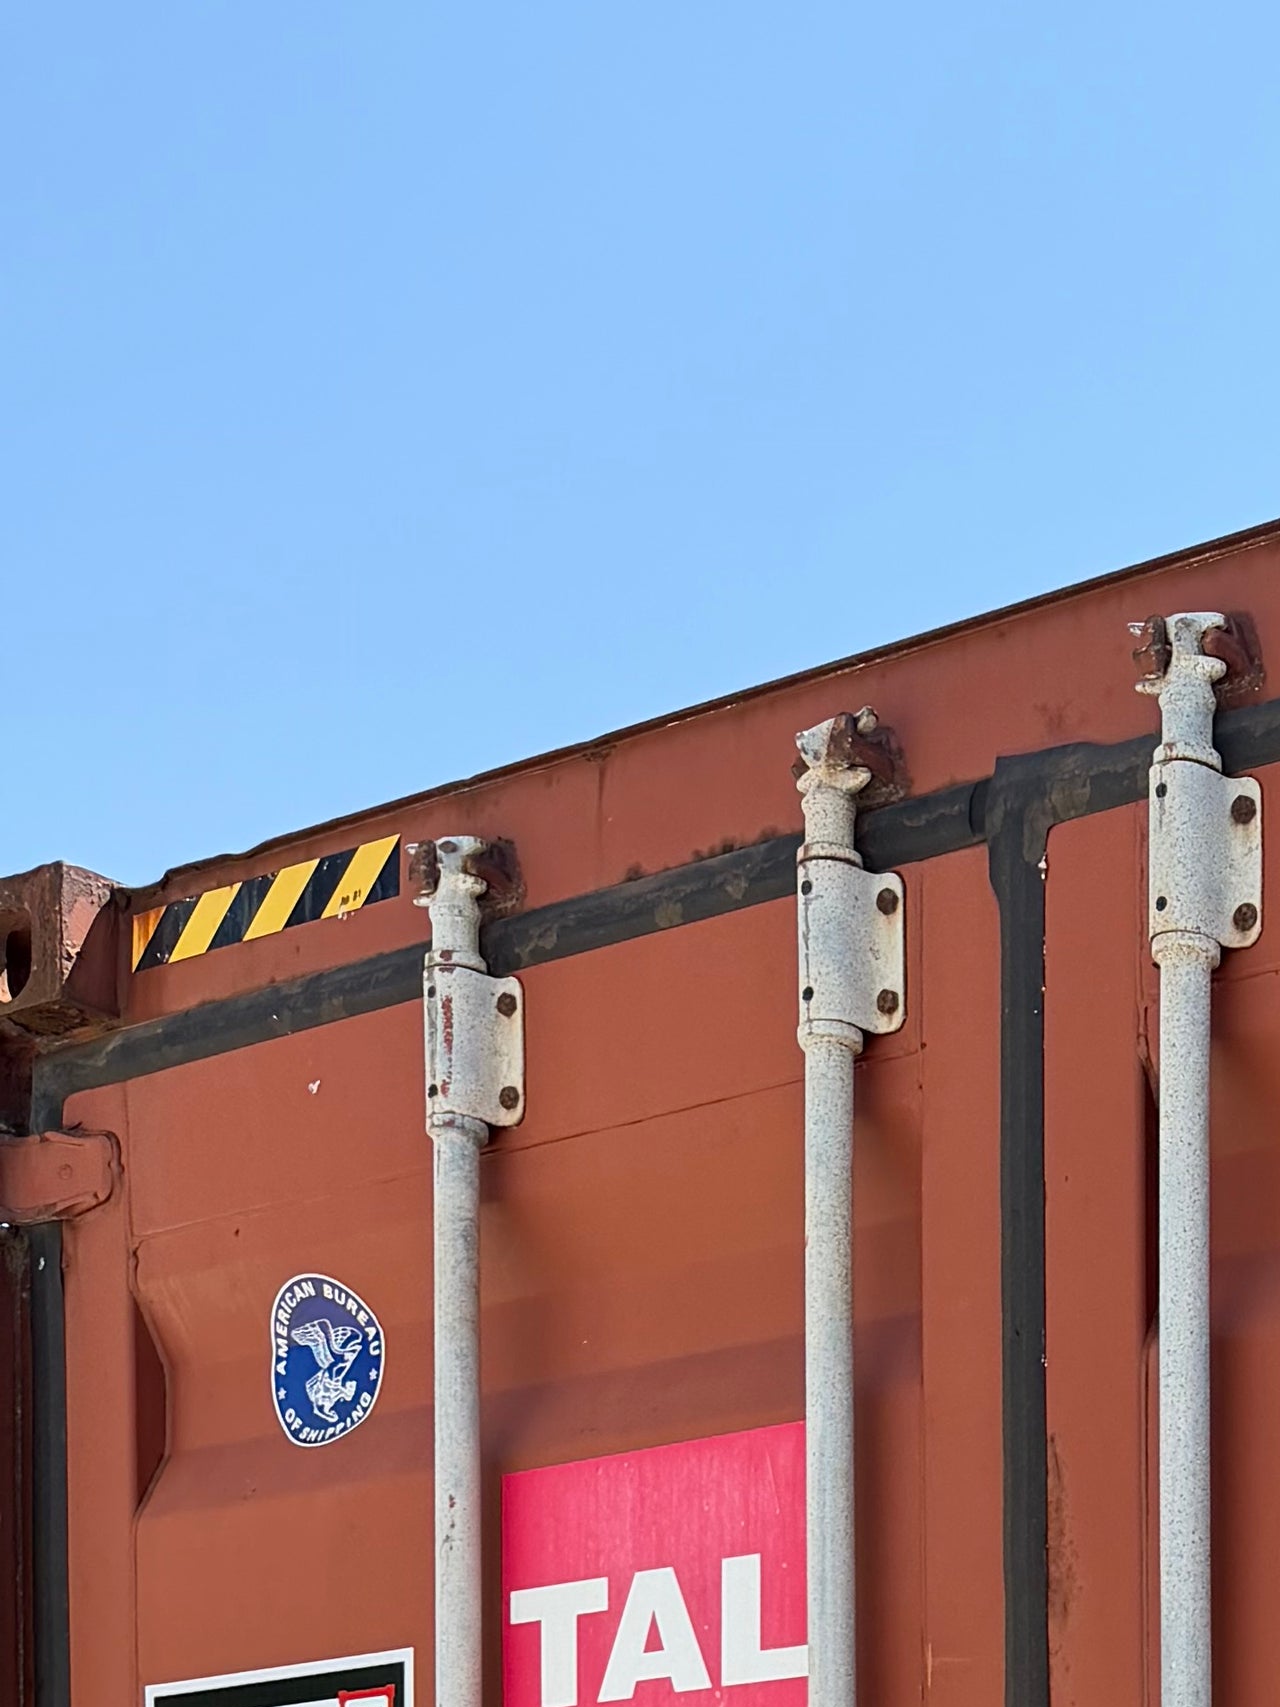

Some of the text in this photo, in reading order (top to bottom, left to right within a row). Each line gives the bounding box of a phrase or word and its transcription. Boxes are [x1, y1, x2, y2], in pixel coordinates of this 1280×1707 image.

[276, 1281, 381, 1375] AMERICAN BUREAU
[284, 1391, 372, 1442] OF SHIPPING
